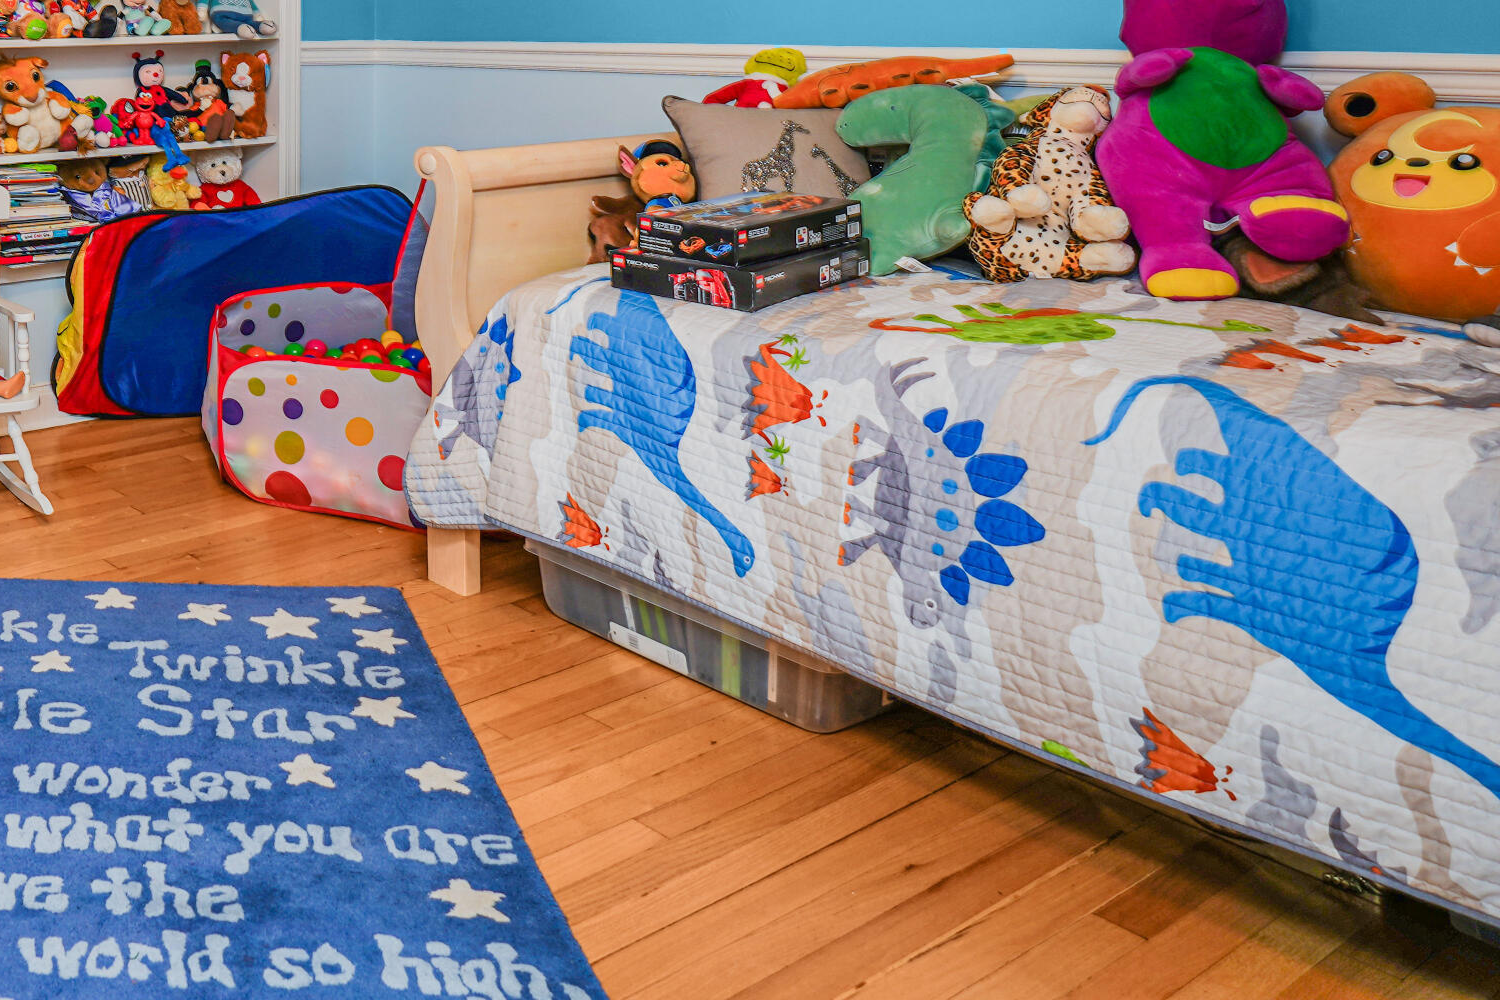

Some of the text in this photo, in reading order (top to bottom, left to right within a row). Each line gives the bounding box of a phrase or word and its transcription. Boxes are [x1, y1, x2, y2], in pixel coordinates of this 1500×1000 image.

[653, 221, 683, 234] SPEED
[107, 639, 406, 689] Twinkle
[137, 683, 358, 744] Star
[12, 758, 273, 803] wonder
[4, 803, 519, 875] what you are
[90, 860, 246, 923] the
[17, 930, 235, 988] world
[263, 943, 356, 988] so
